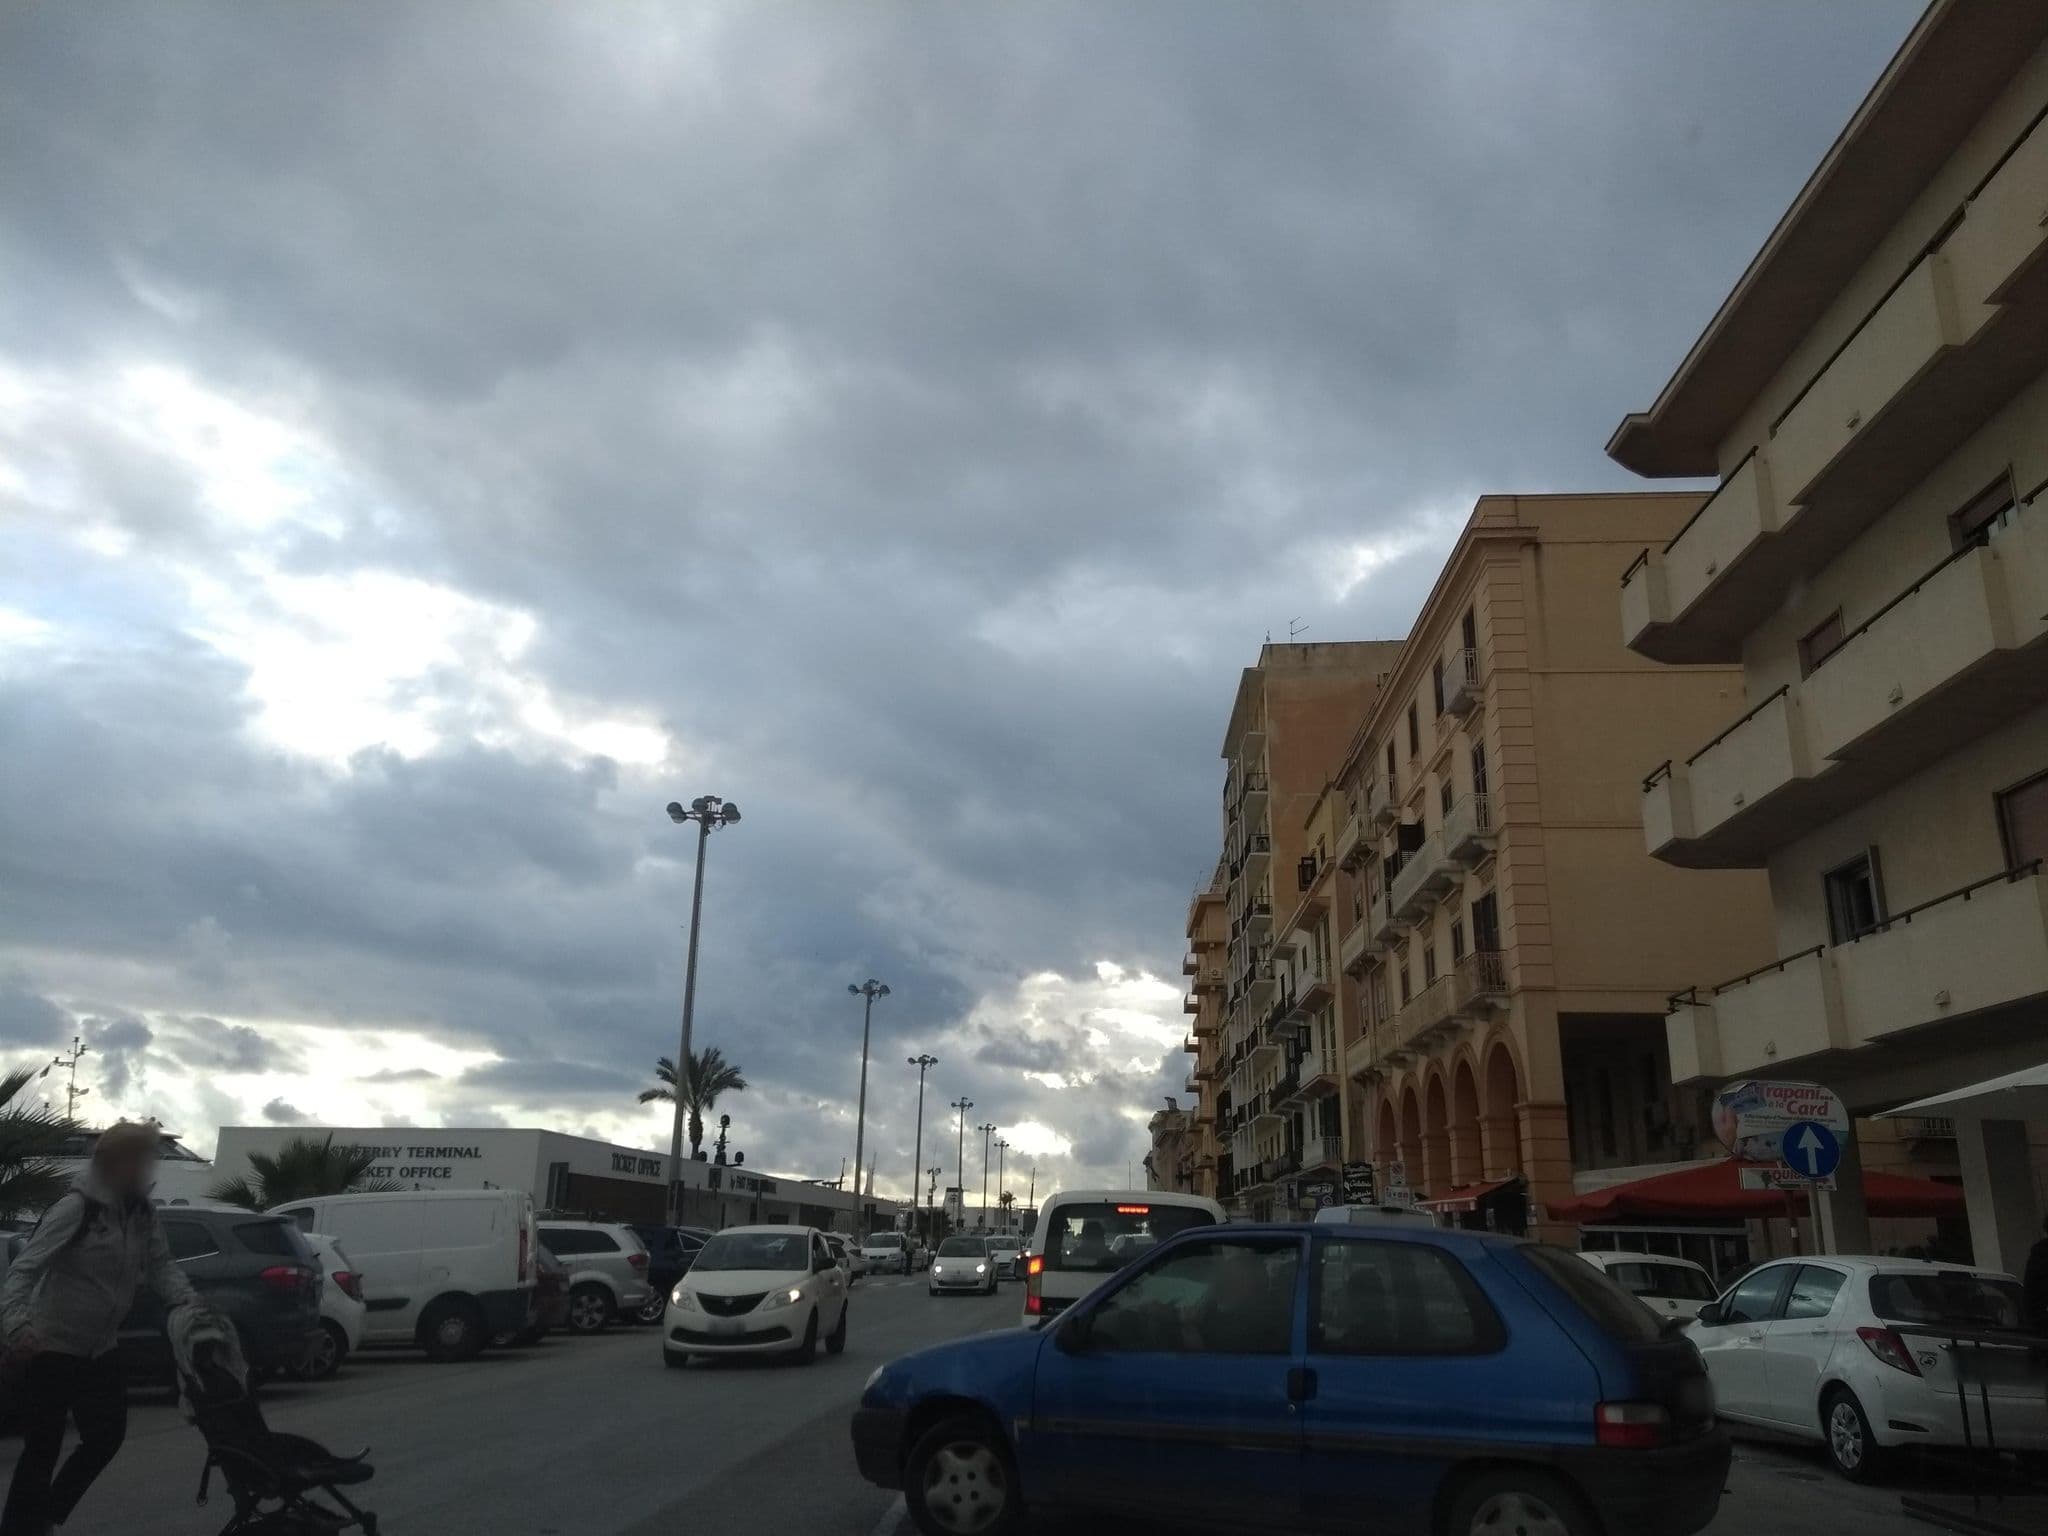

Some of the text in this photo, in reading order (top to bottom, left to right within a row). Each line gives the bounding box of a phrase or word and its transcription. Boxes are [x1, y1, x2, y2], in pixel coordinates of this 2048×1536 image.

[1786, 1100, 1828, 1115] Card
[407, 1146, 482, 1159] TERMINAL
[612, 1152, 662, 1177] TICKET OFFICE
[399, 1166, 452, 1179] OFFICE
